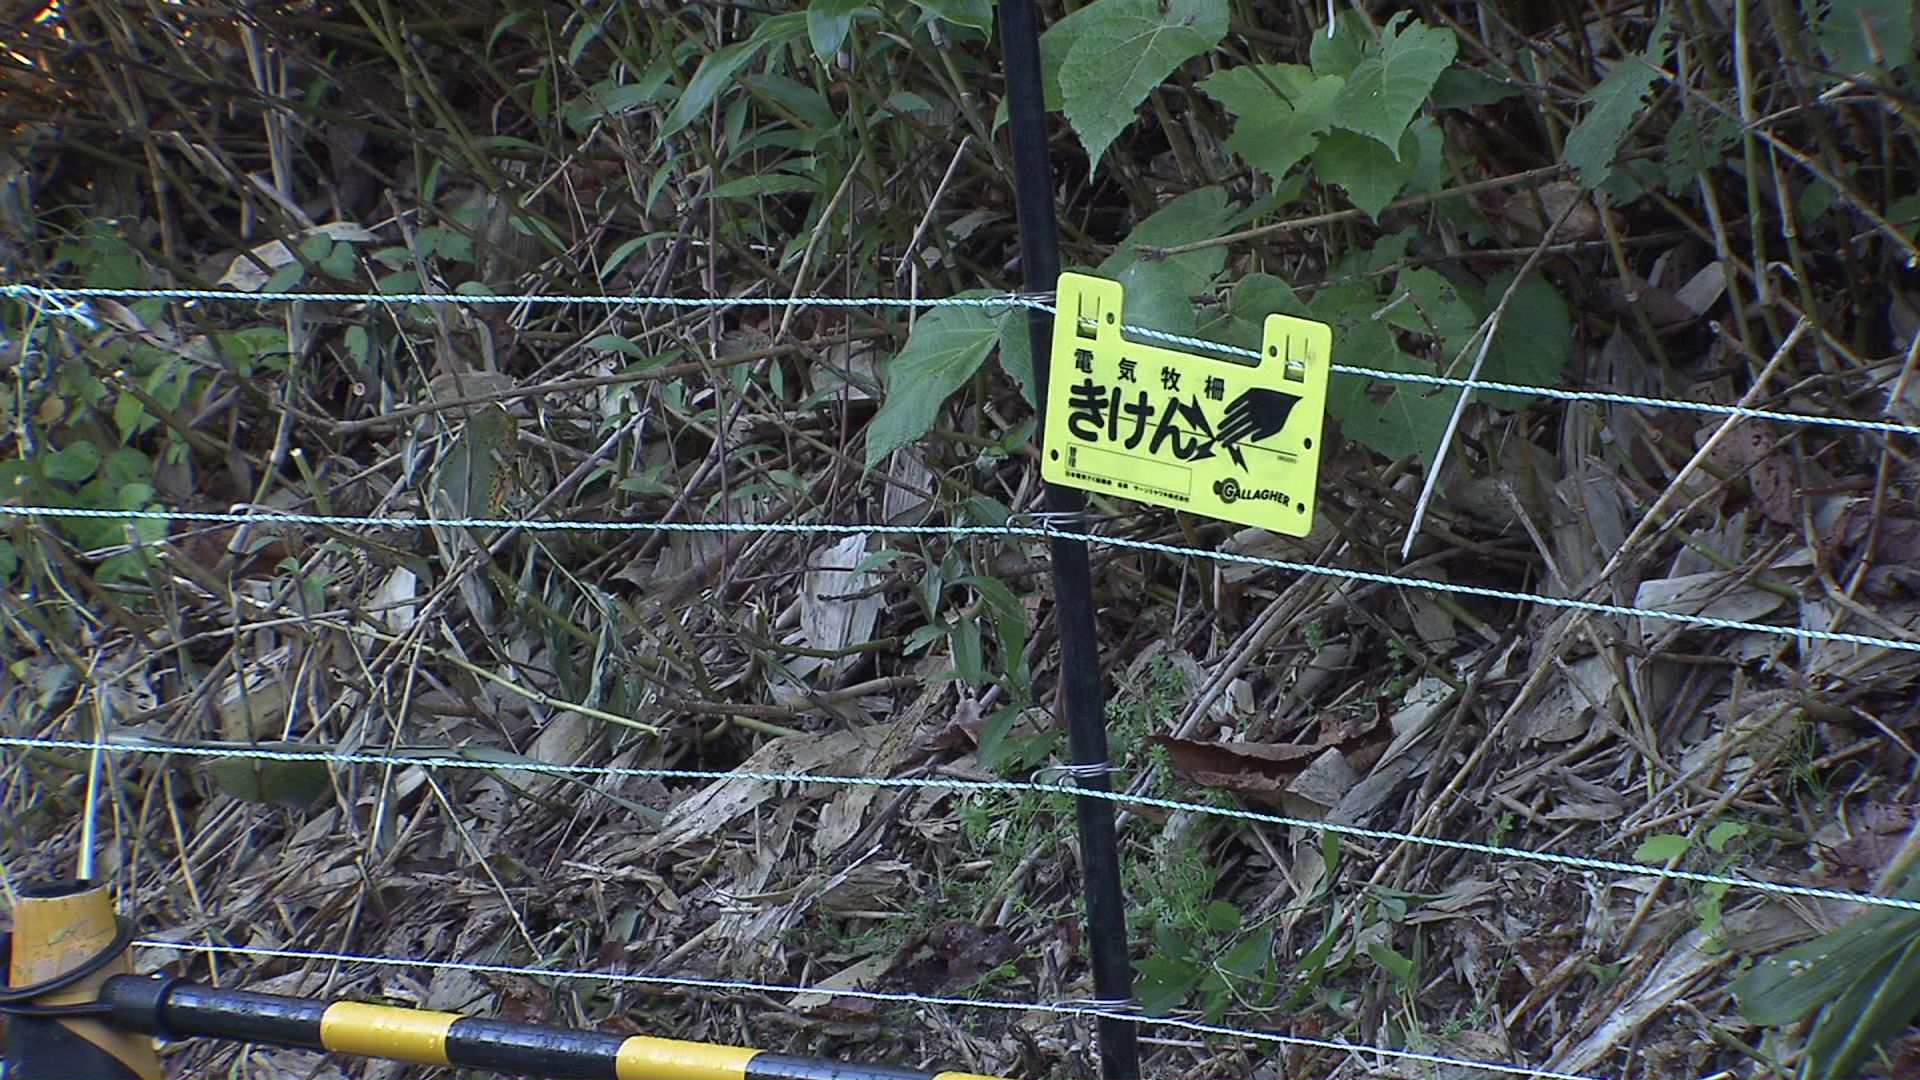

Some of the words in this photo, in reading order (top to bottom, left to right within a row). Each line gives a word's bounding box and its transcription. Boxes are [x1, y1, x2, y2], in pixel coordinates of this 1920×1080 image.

[1074, 348, 1225, 401] 電気牧柵
[1068, 378, 1198, 460] きけん
[1222, 480, 1290, 507] GALLAGHER
